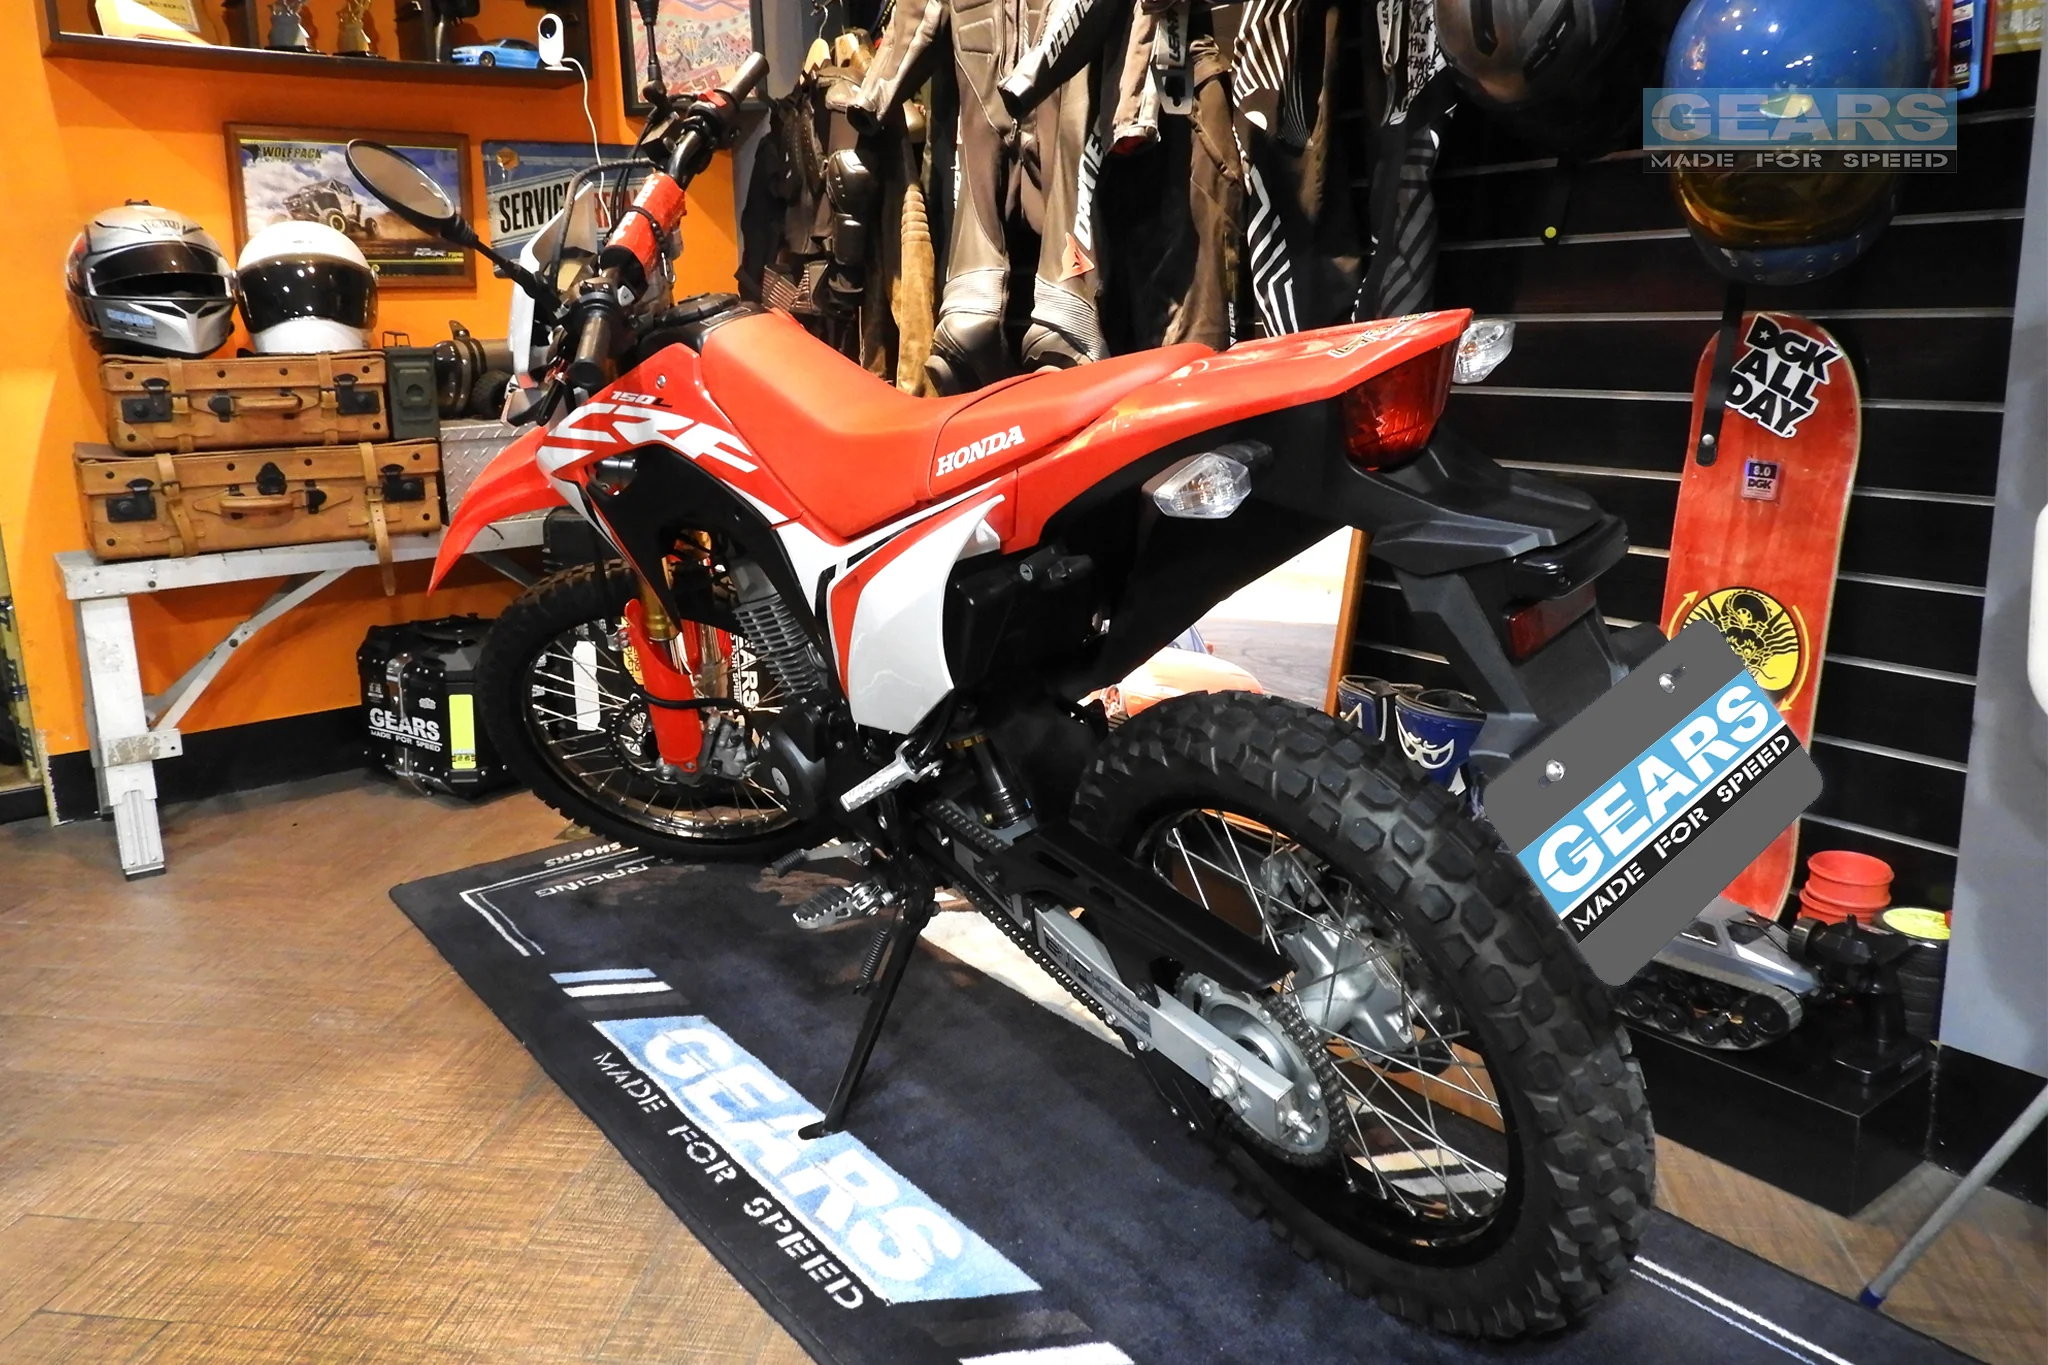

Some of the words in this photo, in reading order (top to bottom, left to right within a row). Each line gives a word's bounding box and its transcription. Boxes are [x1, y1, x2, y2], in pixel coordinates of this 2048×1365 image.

[1746, 315, 1838, 382] DGK
[1734, 347, 1815, 411] ALL
[611, 390, 673, 408] 150L
[547, 401, 759, 474] CRF
[936, 425, 1026, 477] HONDA
[1747, 478, 1773, 490] DGK
[1753, 466, 1771, 478] 8.0
[369, 707, 441, 742] GEARS
[370, 730, 392, 740] MADE
[395, 735, 413, 745] FOR
[415, 740, 442, 753] SPEED
[544, 841, 623, 868] SHOCKS
[534, 863, 650, 898] RACING
[645, 1027, 963, 1282] GEARS
[593, 1051, 668, 1114] MADE
[667, 1123, 737, 1184] FOR
[742, 1196, 865, 1310] SPEED
